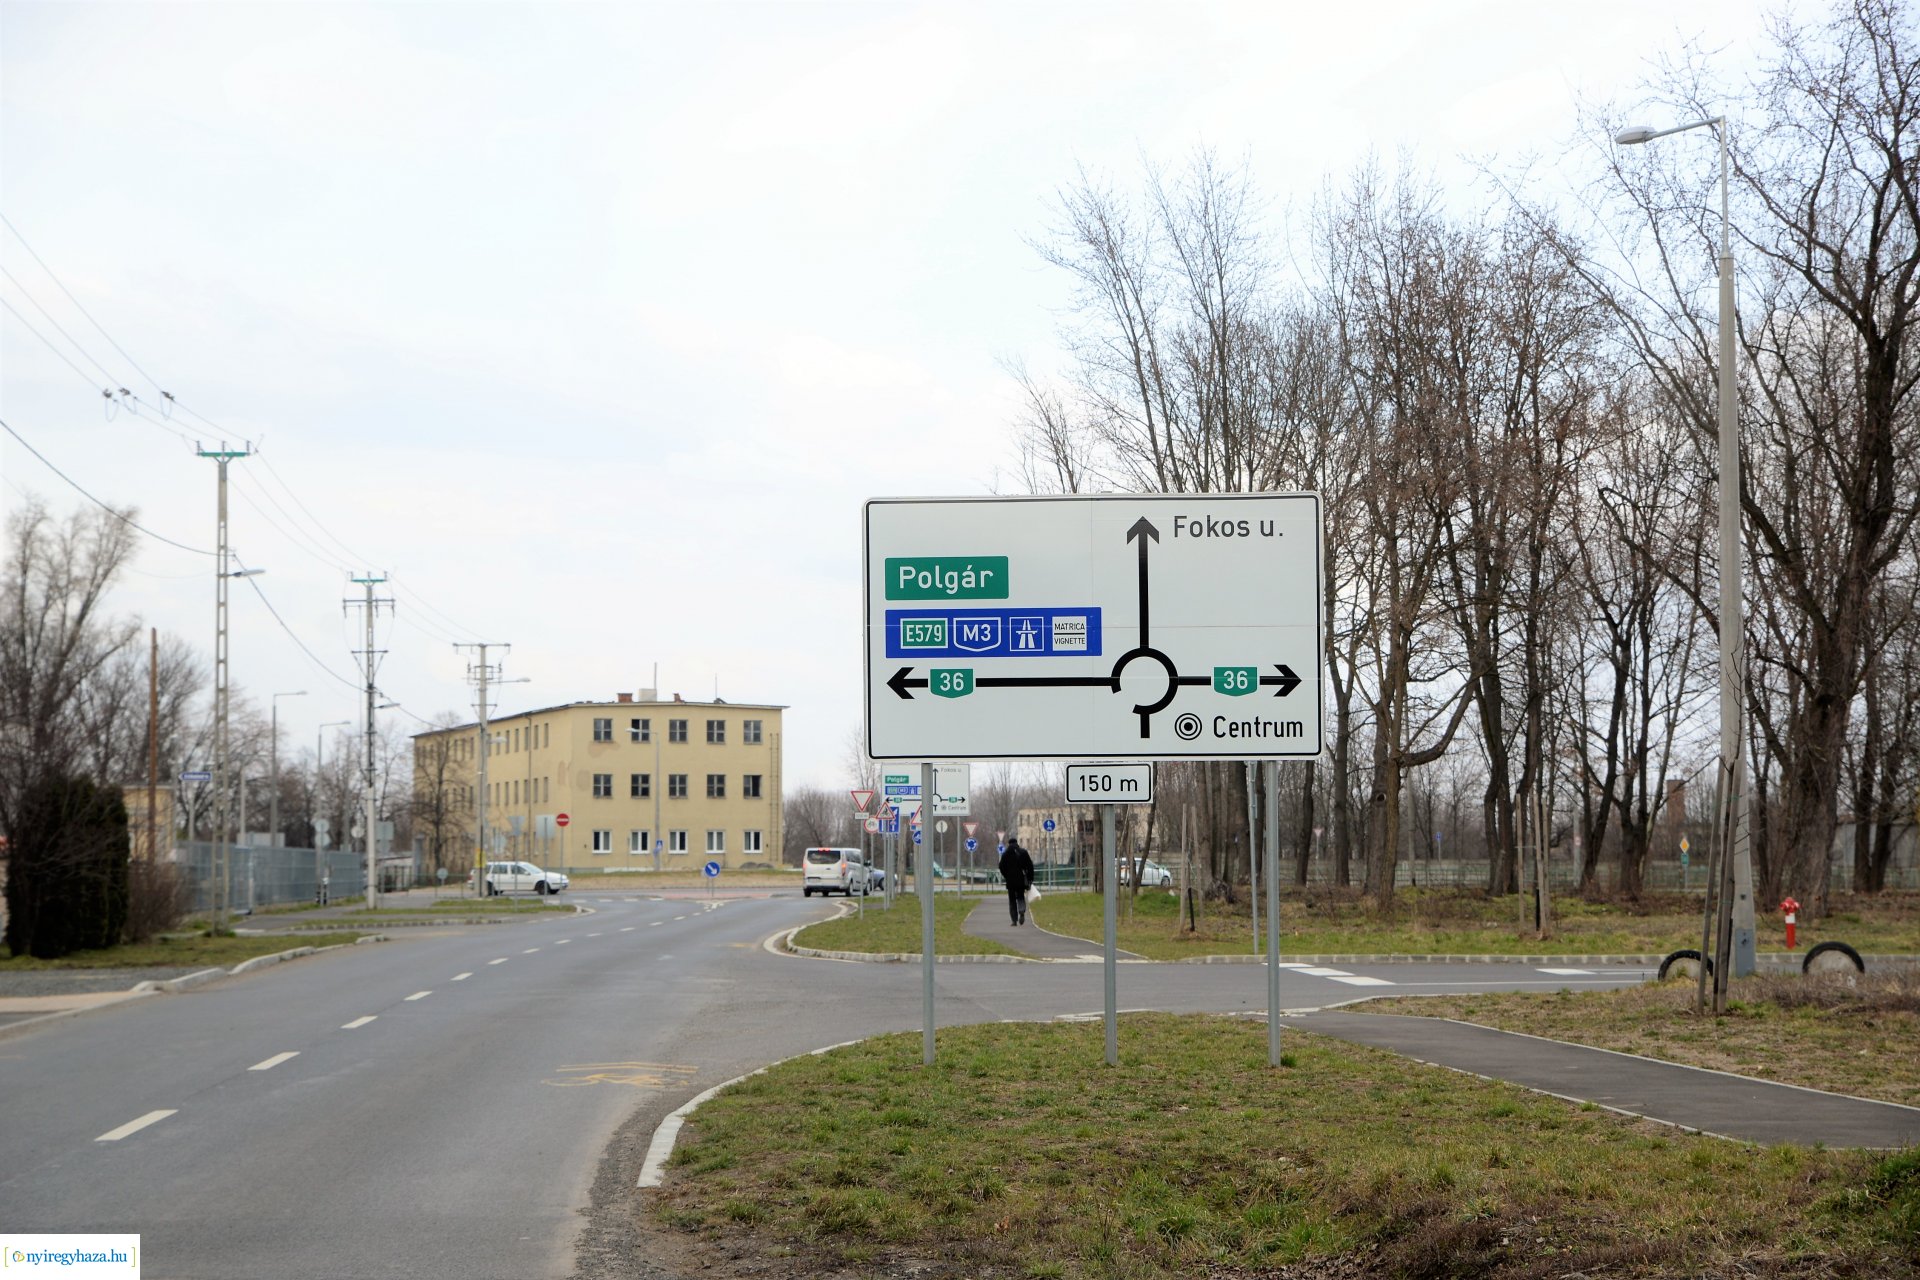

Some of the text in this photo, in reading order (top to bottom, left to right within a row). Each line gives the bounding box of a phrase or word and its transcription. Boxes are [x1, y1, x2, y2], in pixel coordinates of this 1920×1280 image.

[1174, 515, 1284, 538] Fokos u.
[898, 565, 993, 595] Polgár
[906, 624, 942, 643] E579
[963, 623, 991, 642] M3
[1054, 622, 1085, 631] MATRICA
[1054, 637, 1085, 645] VIGNETTE
[939, 672, 965, 691] 36
[1223, 671, 1248, 690] 36
[1213, 715, 1303, 739] Centrum
[1080, 774, 1138, 792] 150 m
